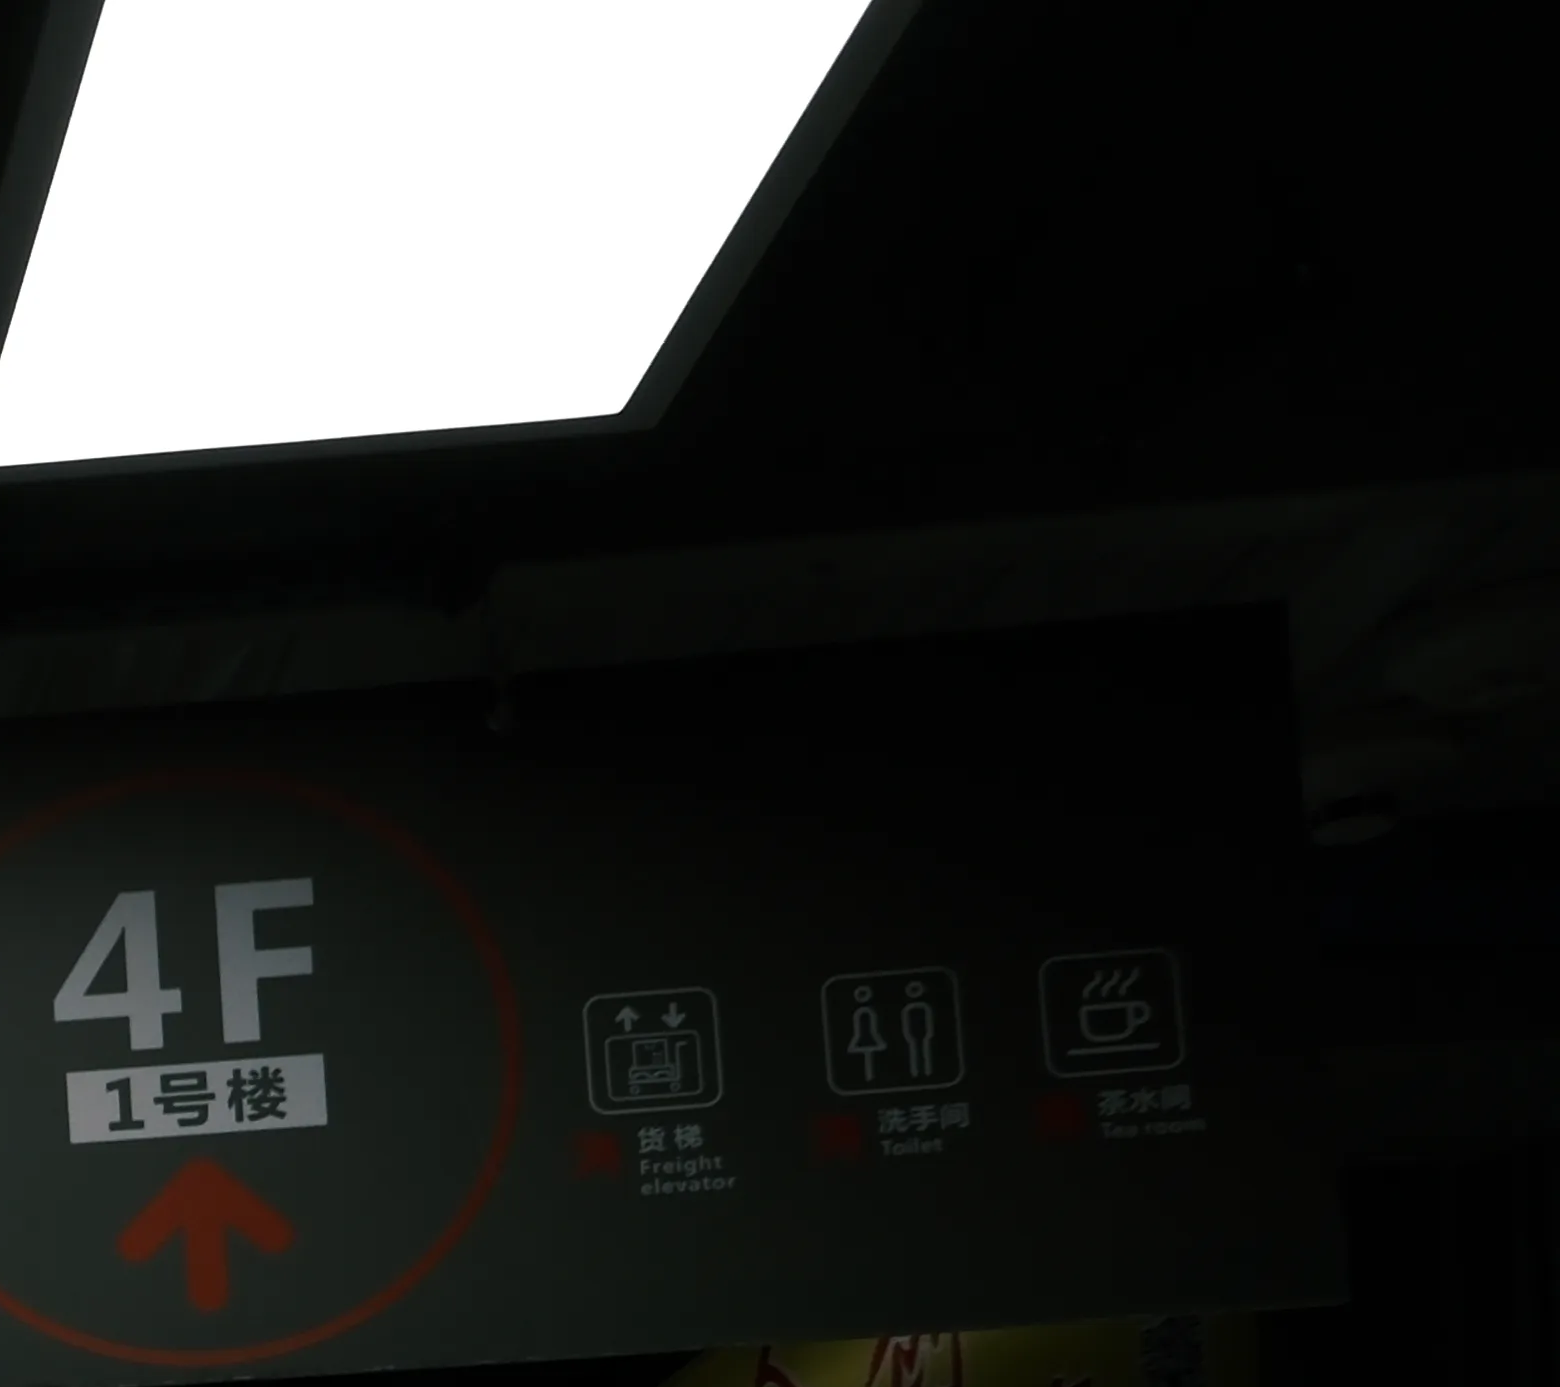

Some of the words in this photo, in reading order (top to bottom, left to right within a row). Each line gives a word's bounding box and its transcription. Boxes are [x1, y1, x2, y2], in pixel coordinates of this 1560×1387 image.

[52, 876, 316, 1053] 4F
[104, 1066, 288, 1131] 1号楼
[1096, 1083, 1195, 1118] 茶水间
[876, 1101, 972, 1135] 洗手间
[1099, 1117, 1141, 1141] Tea
[636, 1123, 706, 1155] 货梯
[879, 1133, 946, 1158] Toilet
[638, 1153, 726, 1180] Freight
[639, 1173, 738, 1198] elevator
